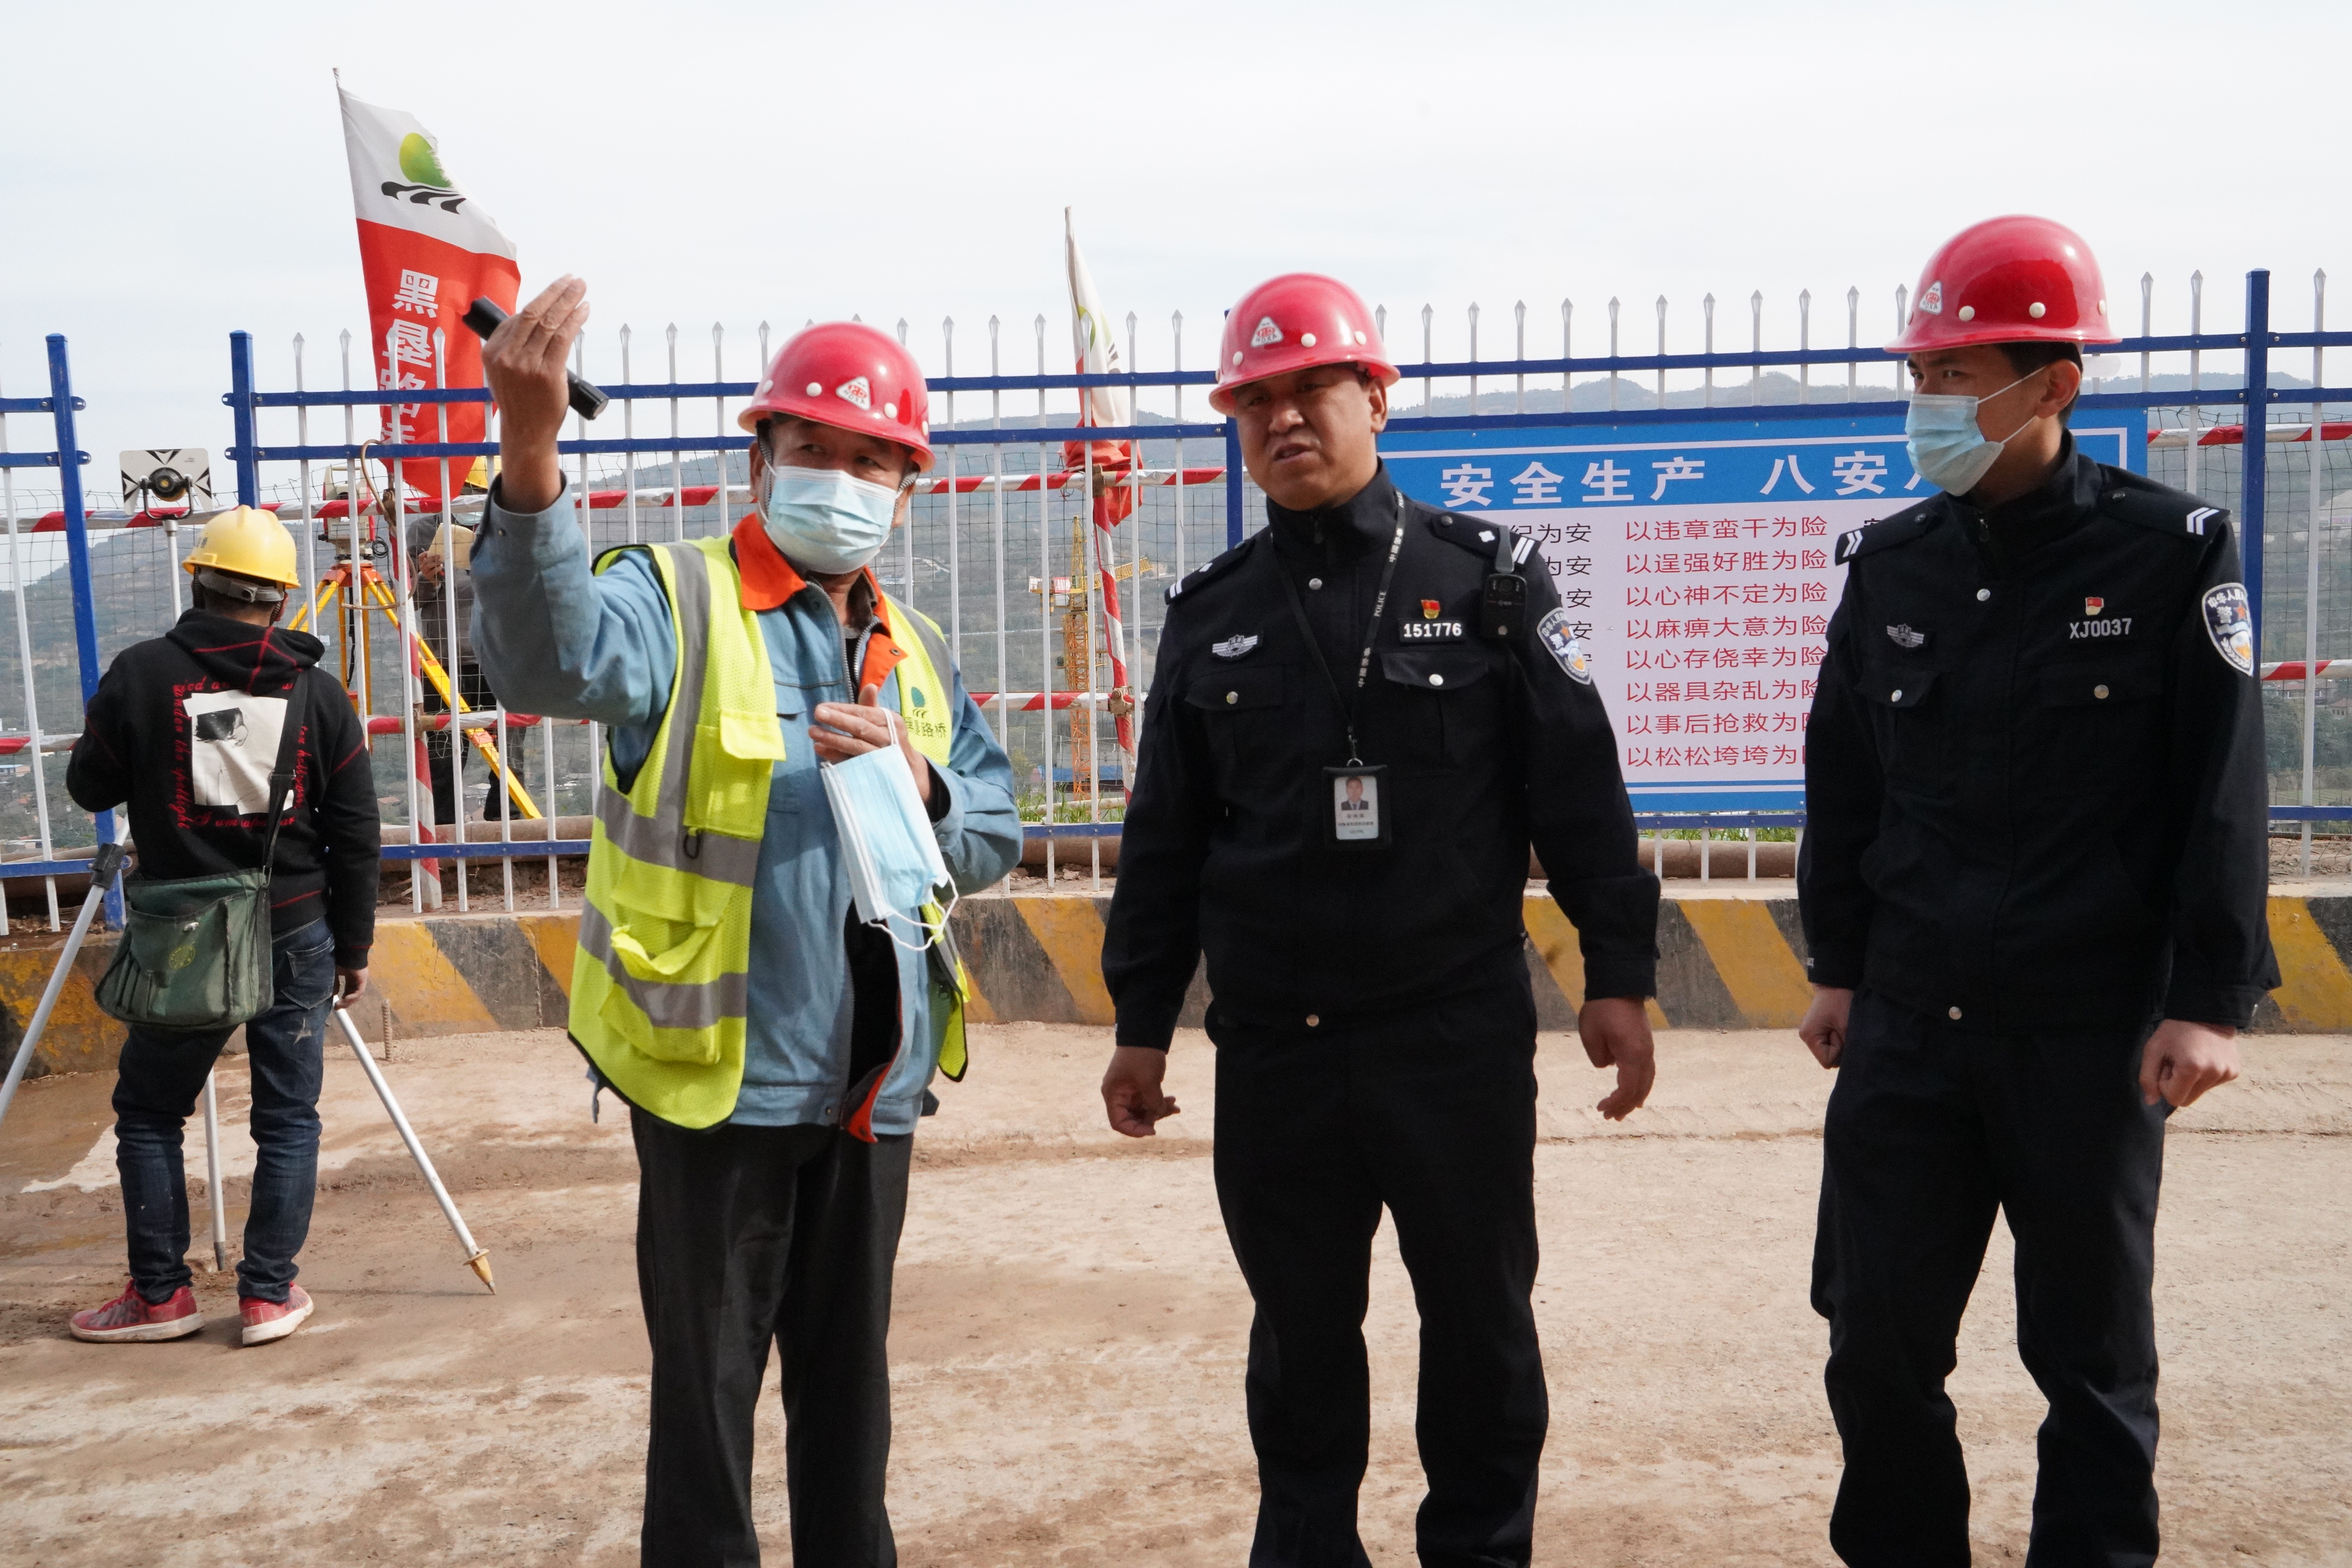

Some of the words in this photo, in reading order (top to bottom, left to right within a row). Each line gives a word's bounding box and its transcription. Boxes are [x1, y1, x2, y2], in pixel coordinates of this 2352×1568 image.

[1440, 456, 1706, 508] 安全生产
[1759, 450, 1922, 496] 八安
[1625, 515, 1828, 542] 以违章蛮干为险
[1626, 548, 1828, 574] 以逞强好胜为险
[1373, 590, 1387, 618] POLICE
[1626, 582, 1828, 607] 以心神不定为险
[1403, 622, 1462, 638] 151776
[1626, 614, 1828, 639] 以麻痹大意为险
[2069, 618, 2132, 639] XJ0037
[1626, 645, 1827, 670] 以心存侥幸为险
[1627, 744, 1806, 767] 以松松垮垮为
